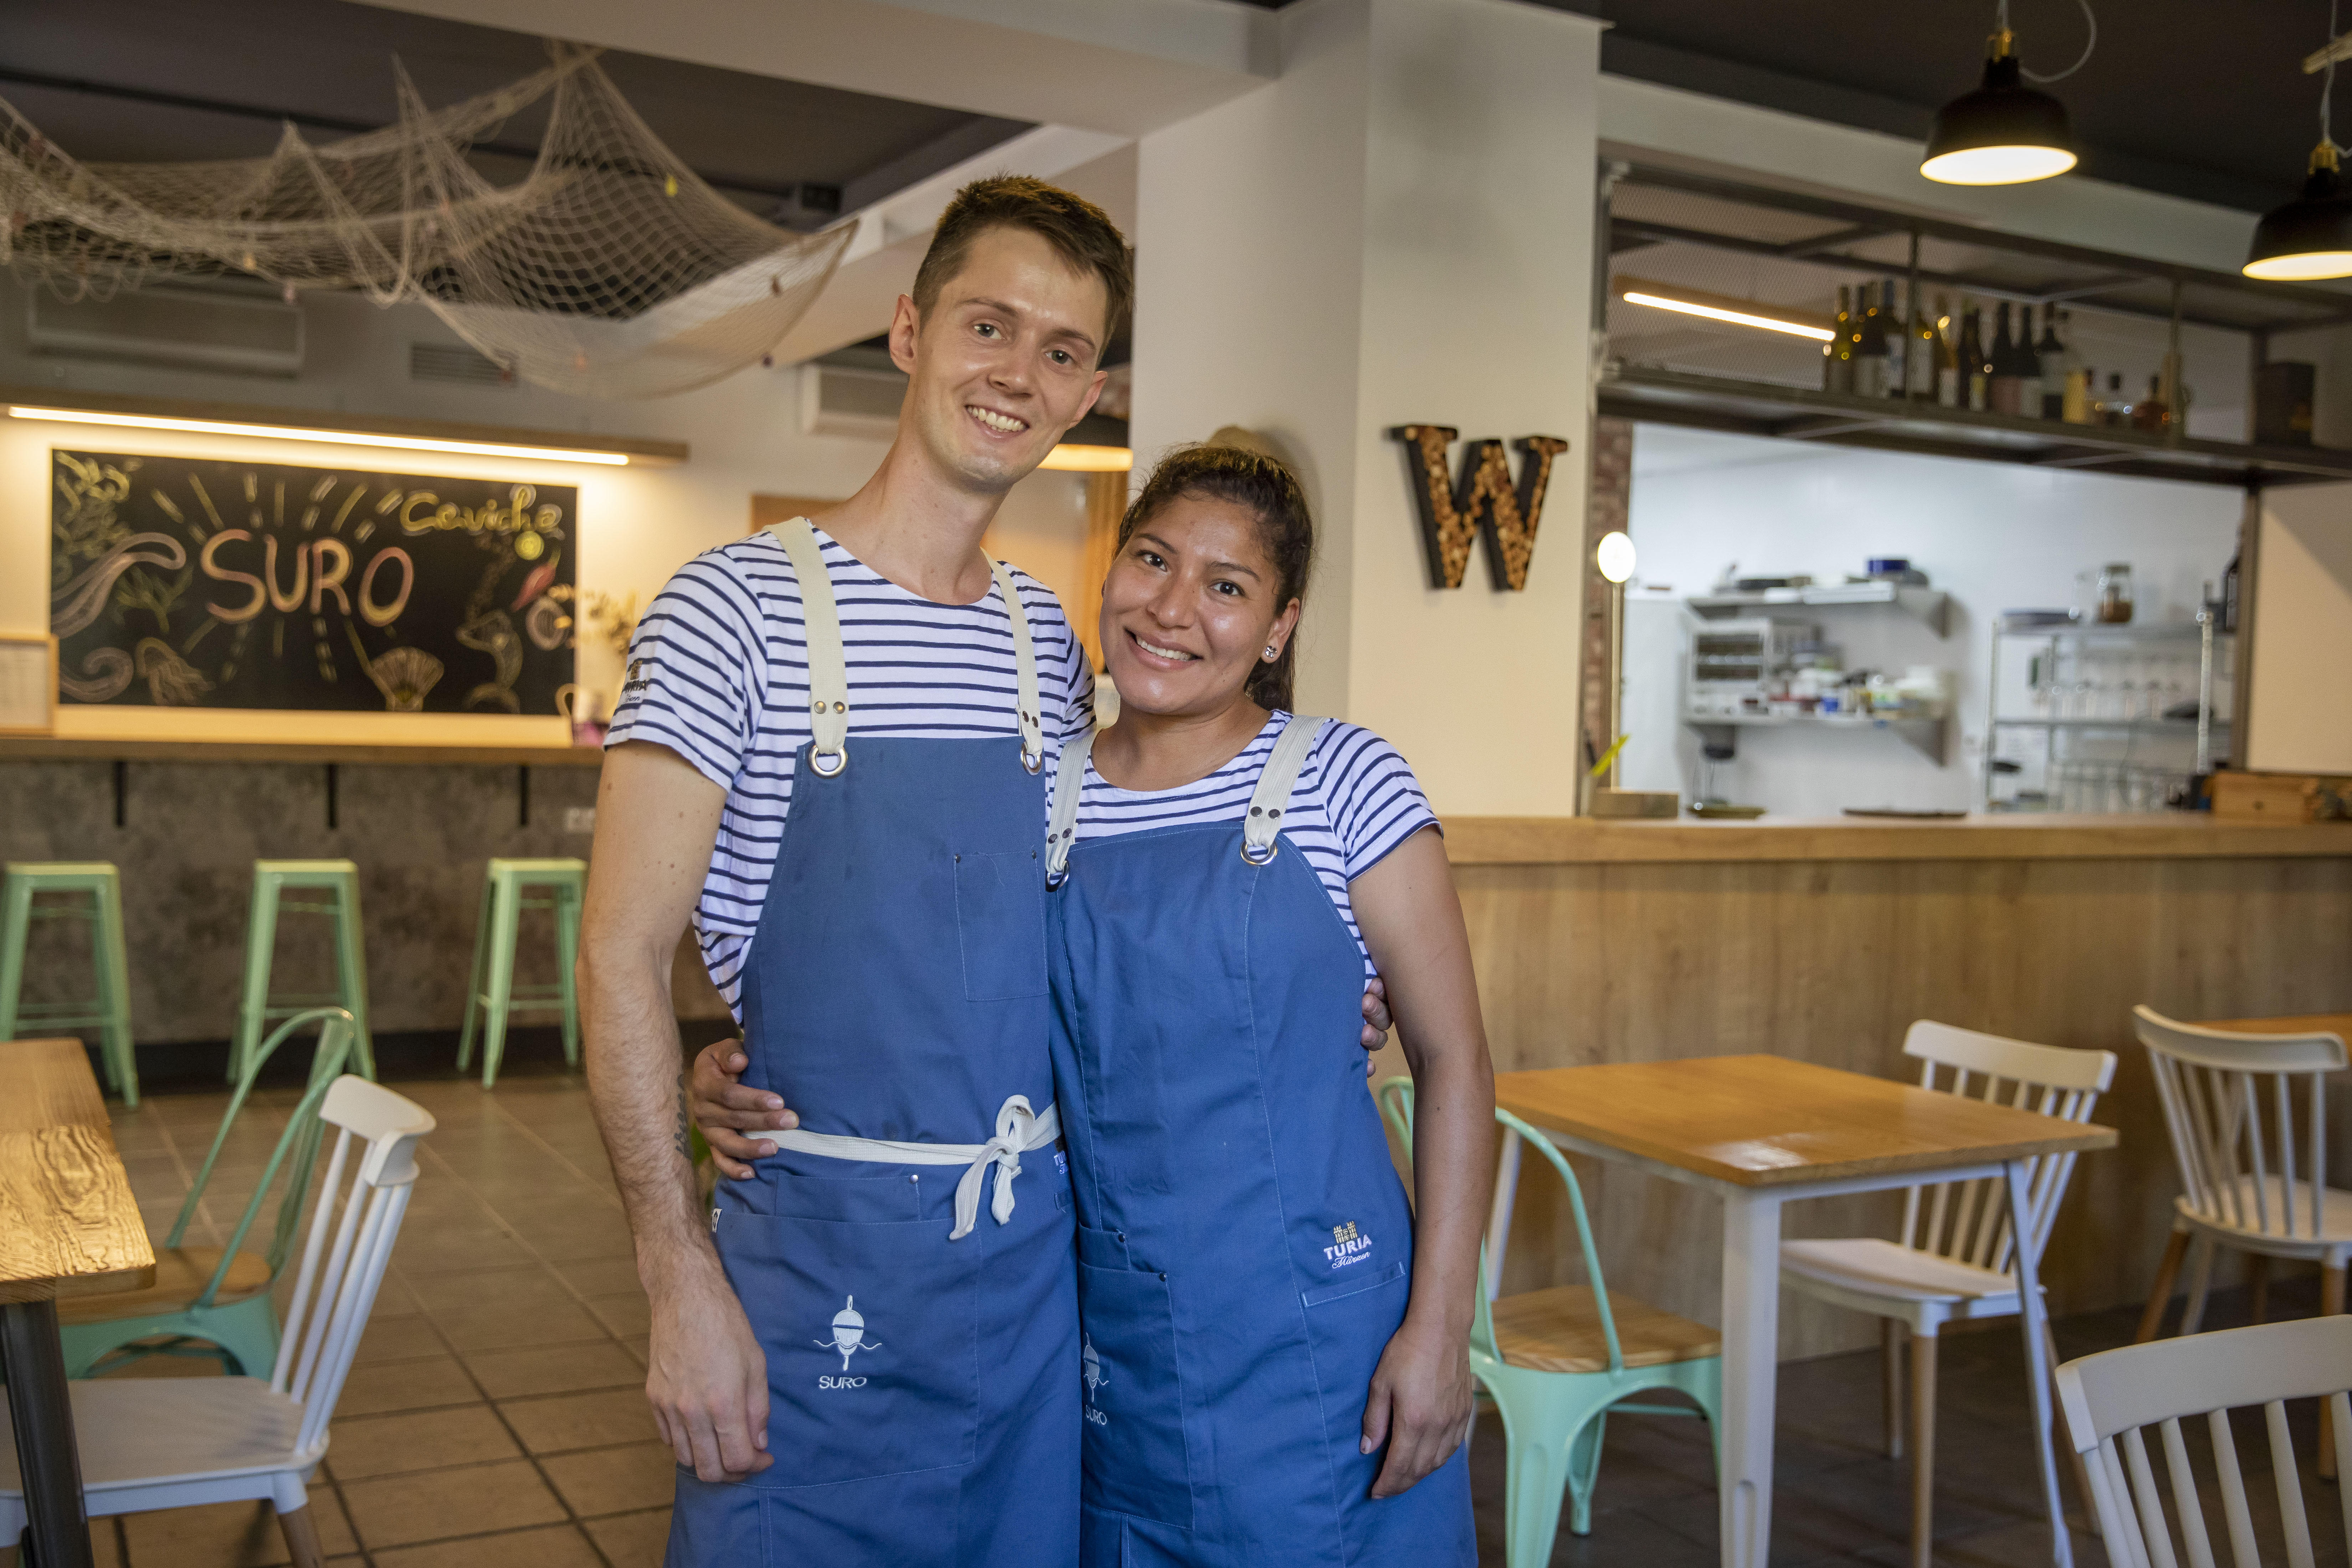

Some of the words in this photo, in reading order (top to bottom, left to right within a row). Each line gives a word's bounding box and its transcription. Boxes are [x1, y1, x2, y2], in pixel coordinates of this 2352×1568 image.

[399, 483, 565, 536] Ceviche
[1379, 424, 1568, 592] W
[200, 528, 414, 627] SURO
[1323, 1234, 1372, 1260] TURIA
[1332, 1251, 1370, 1269] Märzen
[819, 1375, 867, 1389] SURO
[1086, 1404, 1107, 1425] SURO
